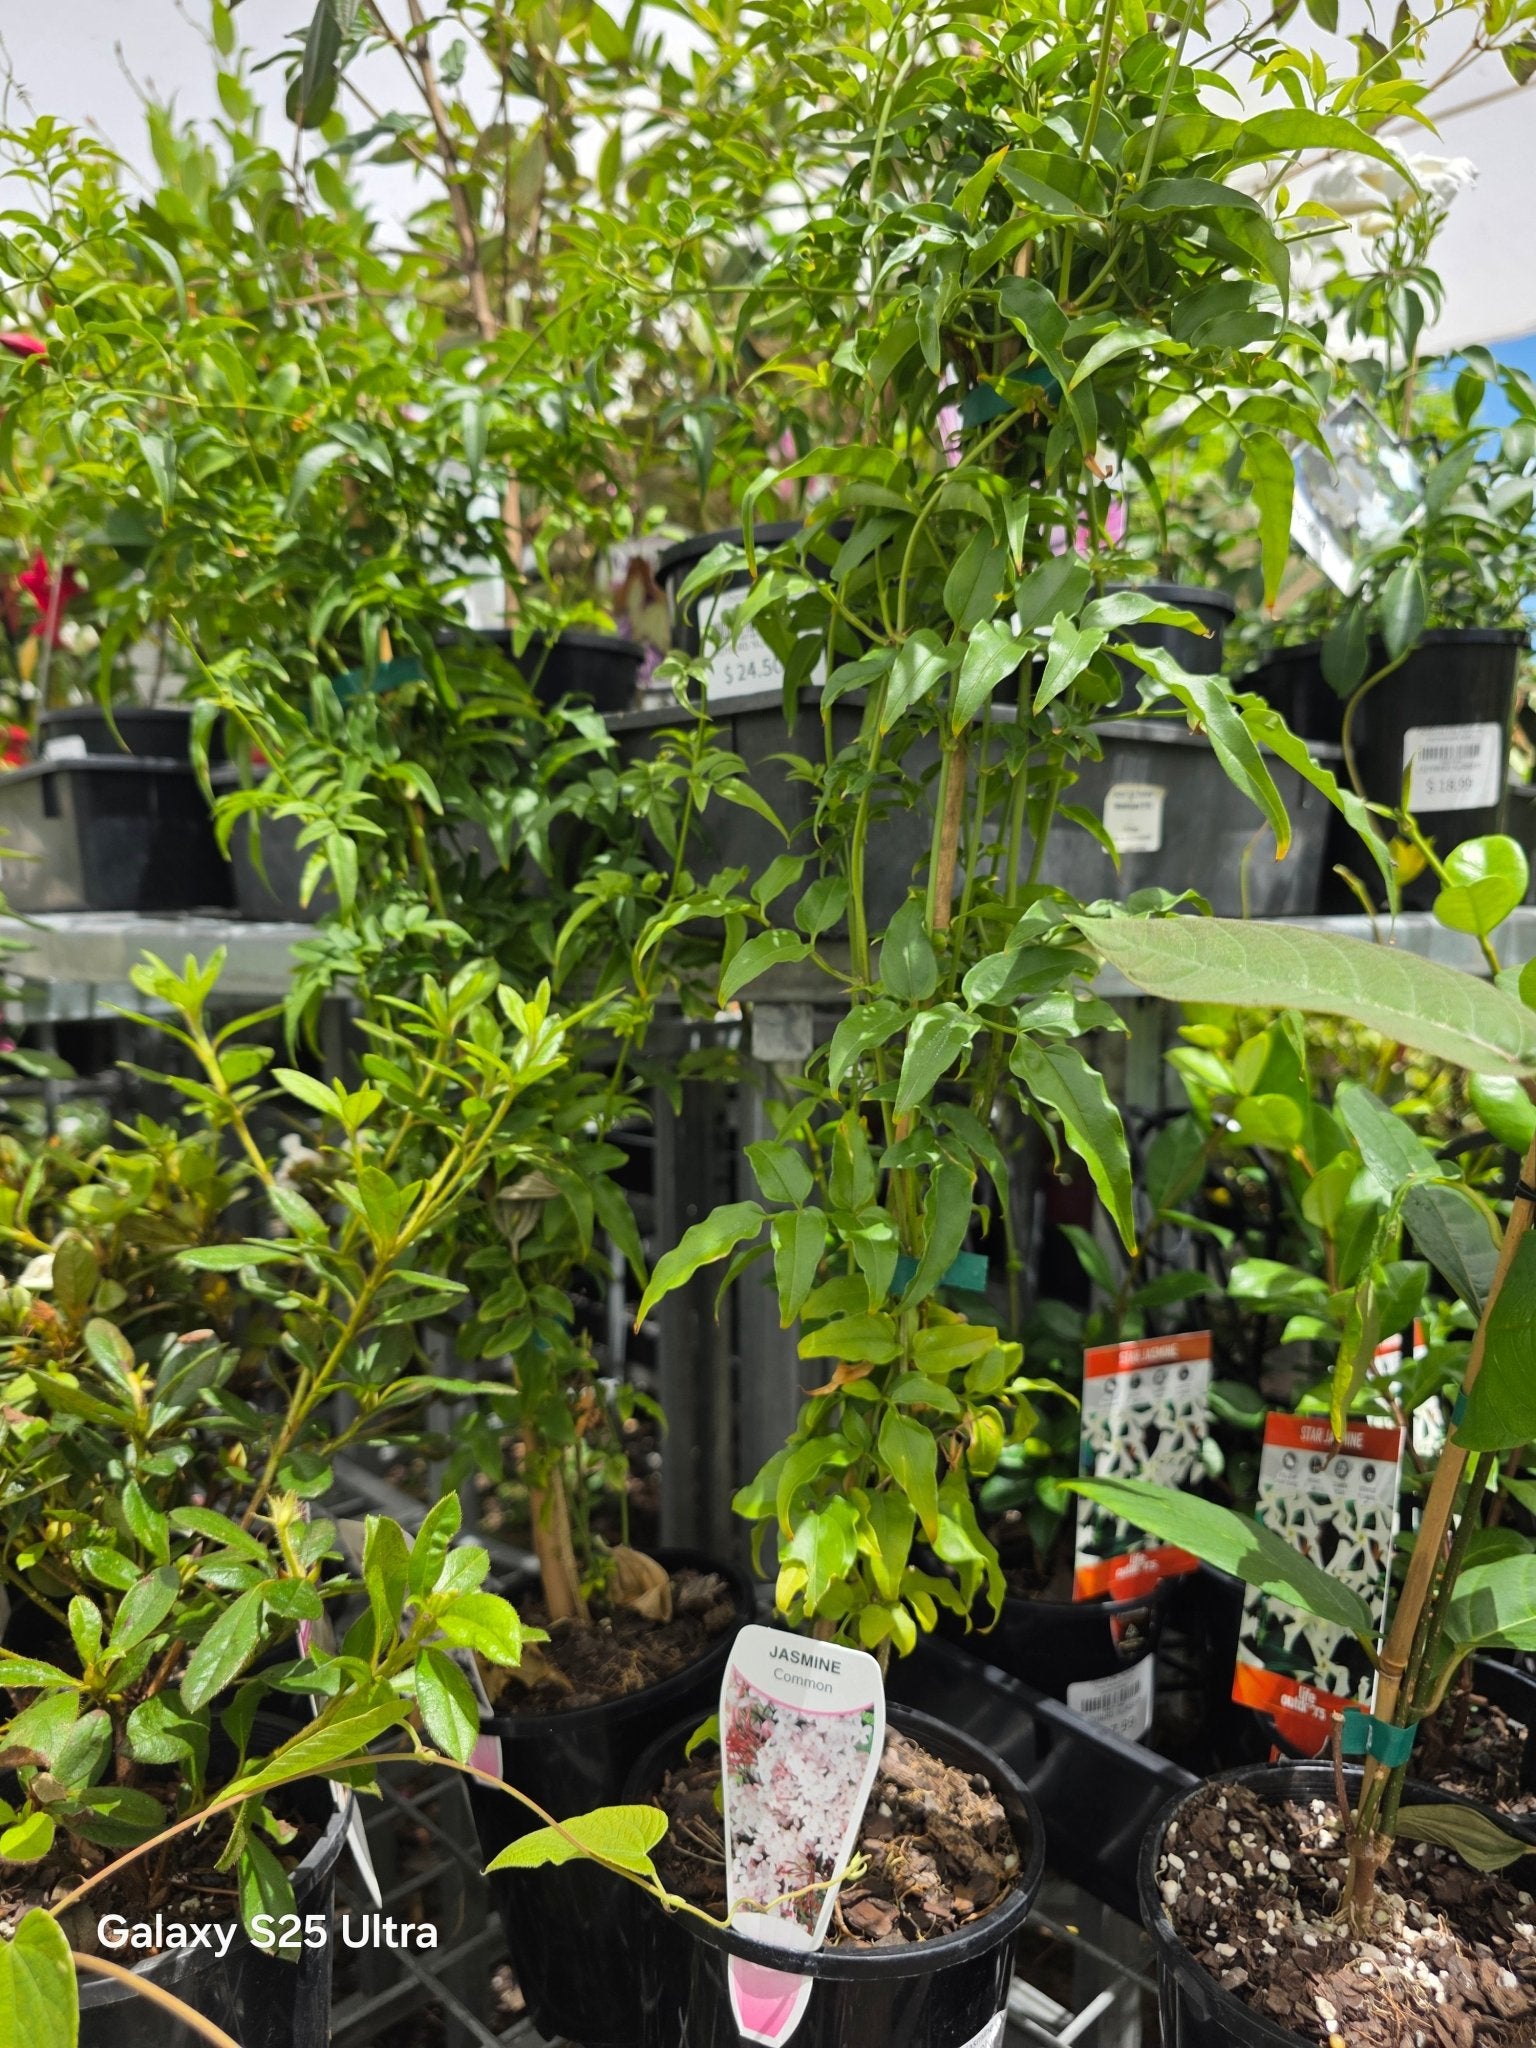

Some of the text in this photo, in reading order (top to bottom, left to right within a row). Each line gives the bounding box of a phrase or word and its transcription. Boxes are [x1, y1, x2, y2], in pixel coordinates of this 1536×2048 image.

[1300, 1425, 1323, 1443] STAR
[769, 1645, 841, 1675] JASMINE
[773, 1667, 833, 1694] Common
